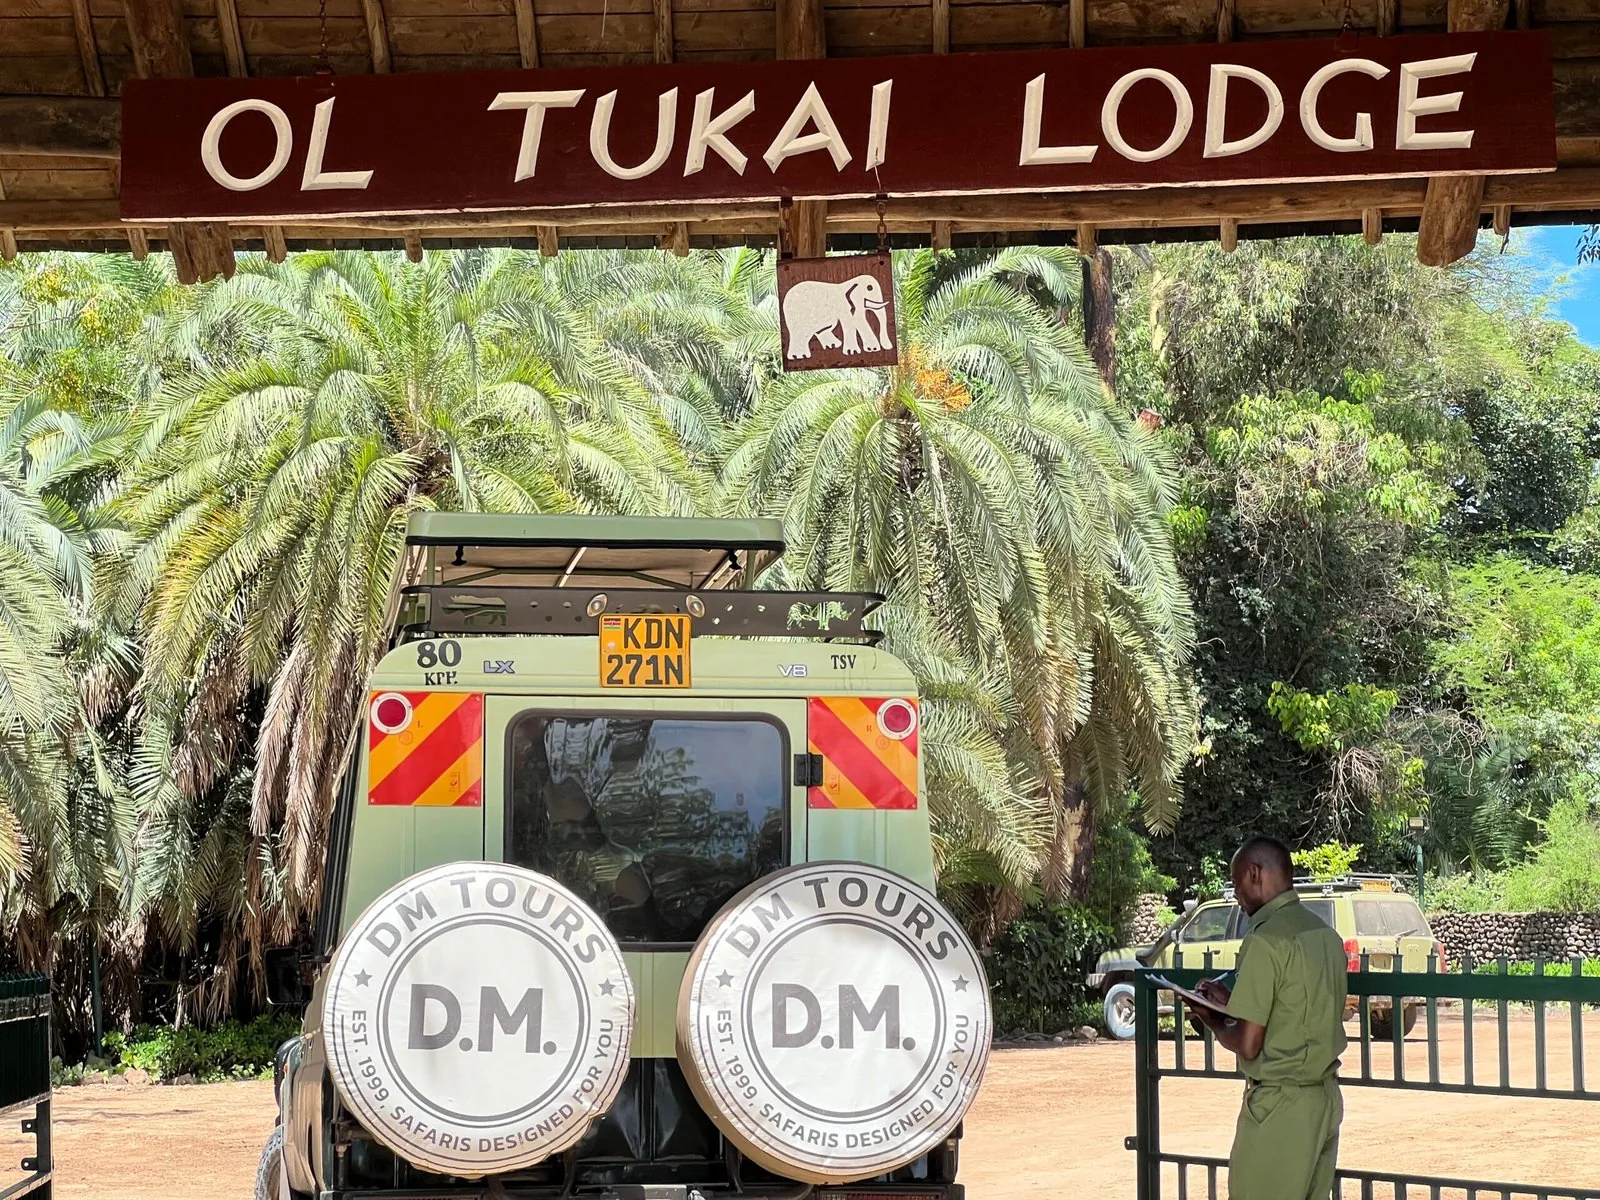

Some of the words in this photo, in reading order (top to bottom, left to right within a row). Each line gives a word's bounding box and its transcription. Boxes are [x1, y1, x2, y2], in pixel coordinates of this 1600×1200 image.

[201, 96, 374, 192] OL
[487, 79, 893, 183] TUKAI
[1019, 51, 1478, 166] LODGE
[417, 640, 462, 668] 80
[483, 660, 516, 674] LX
[623, 618, 683, 649] KDN
[830, 654, 857, 670] TSV
[606, 654, 684, 685] 271N
[777, 664, 808, 677] V8
[365, 891, 438, 958] DM
[450, 877, 607, 964] TOURS
[725, 892, 795, 959] DM
[803, 877, 959, 961] TOURS
[407, 983, 557, 1055] D.M.
[771, 983, 916, 1051] D.M.
[357, 1056, 390, 1109] 1999,
[390, 1105, 472, 1153] SAFARIS
[478, 1104, 575, 1153] DESIGNED
[571, 1067, 603, 1105] FOR
[594, 1018, 614, 1060] YOU
[724, 1055, 758, 1107] 1999,
[759, 1102, 839, 1149] SAFARIS
[845, 1099, 935, 1149] DESIGNED
[932, 1061, 960, 1100] FOR
[950, 1014, 970, 1055] YOU
